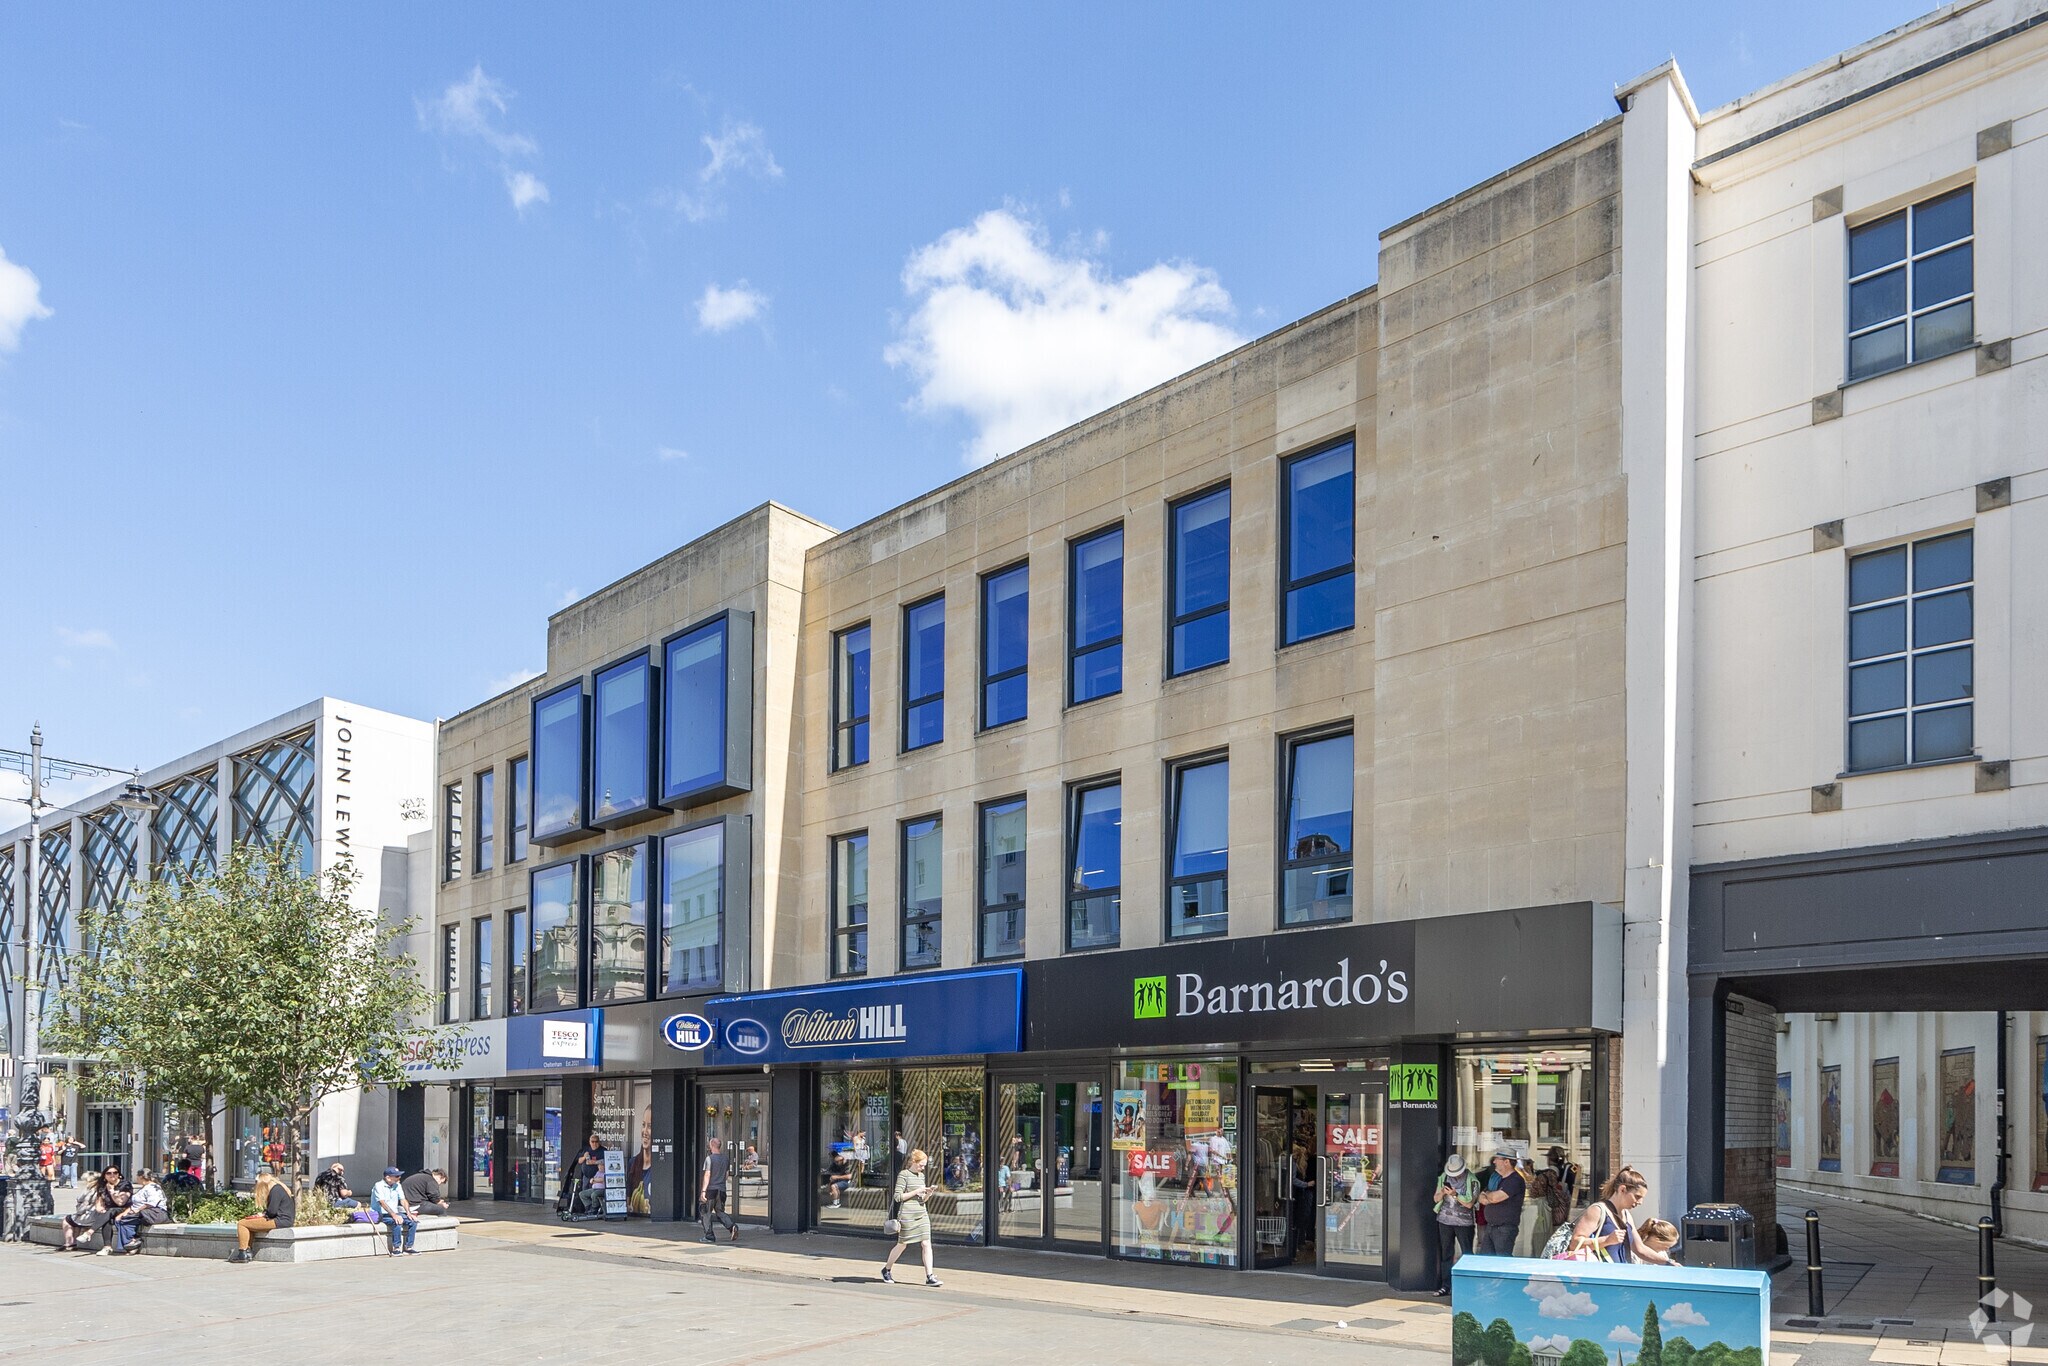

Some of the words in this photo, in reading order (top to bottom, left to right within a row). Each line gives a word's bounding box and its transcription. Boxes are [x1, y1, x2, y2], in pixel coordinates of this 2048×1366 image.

[335, 715, 352, 783] JOHN
[1176, 957, 1409, 1017] Barnardo's
[675, 1020, 701, 1030] William
[781, 1007, 860, 1044] William
[859, 1004, 907, 1039] HILL
[552, 1030, 579, 1038] TESCO
[676, 1030, 702, 1043] HILL
[437, 1035, 491, 1062] express
[1146, 1063, 1201, 1081] HELLO
[593, 1094, 615, 1106] Serving
[867, 1096, 887, 1106] BEST
[593, 1107, 636, 1117] Cheltenham's
[865, 1106, 889, 1116] ODDS
[593, 1119, 620, 1131] shoppers
[608, 1132, 626, 1142] better
[1332, 1127, 1378, 1145] SALE
[1134, 1154, 1170, 1170] SALE
